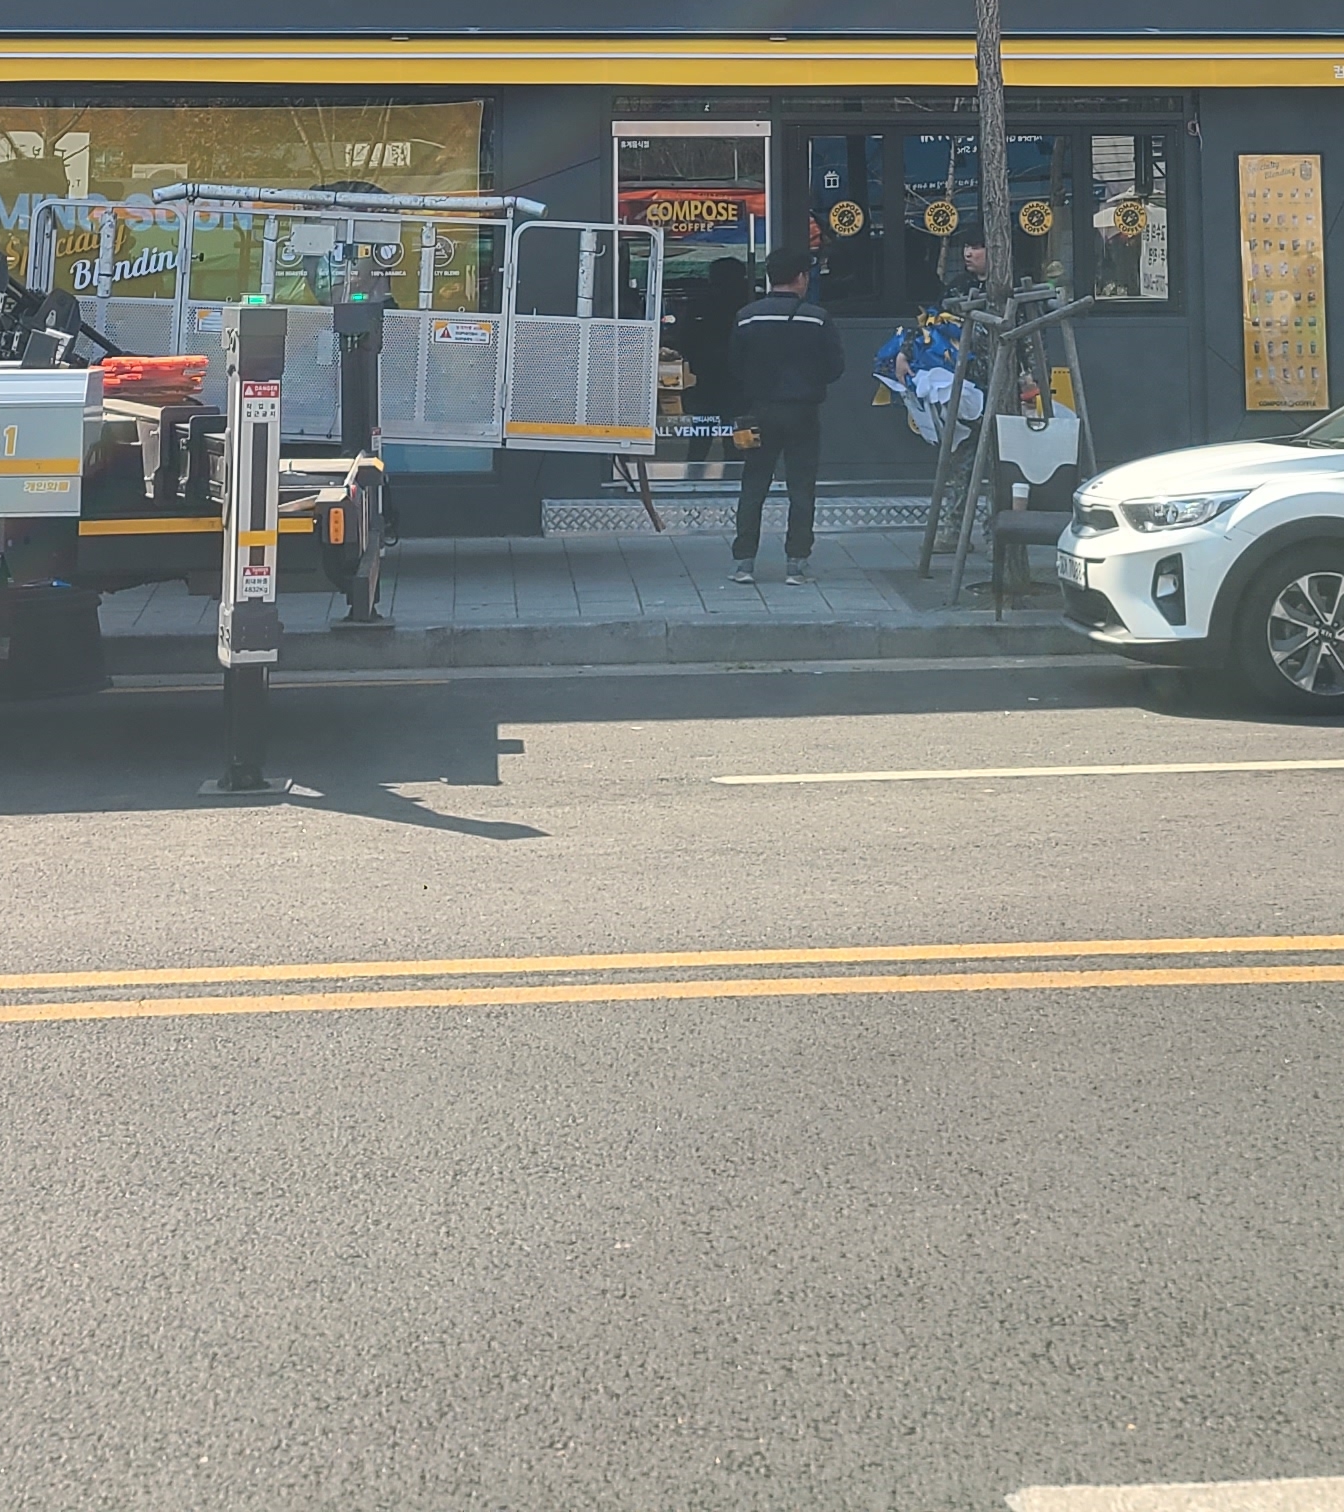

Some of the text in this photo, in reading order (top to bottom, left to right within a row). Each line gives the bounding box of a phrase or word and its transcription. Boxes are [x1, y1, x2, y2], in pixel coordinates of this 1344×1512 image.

[646, 200, 738, 221] COMPOSE
[671, 222, 715, 232] COFFEE
[674, 426, 710, 437] VENTI
